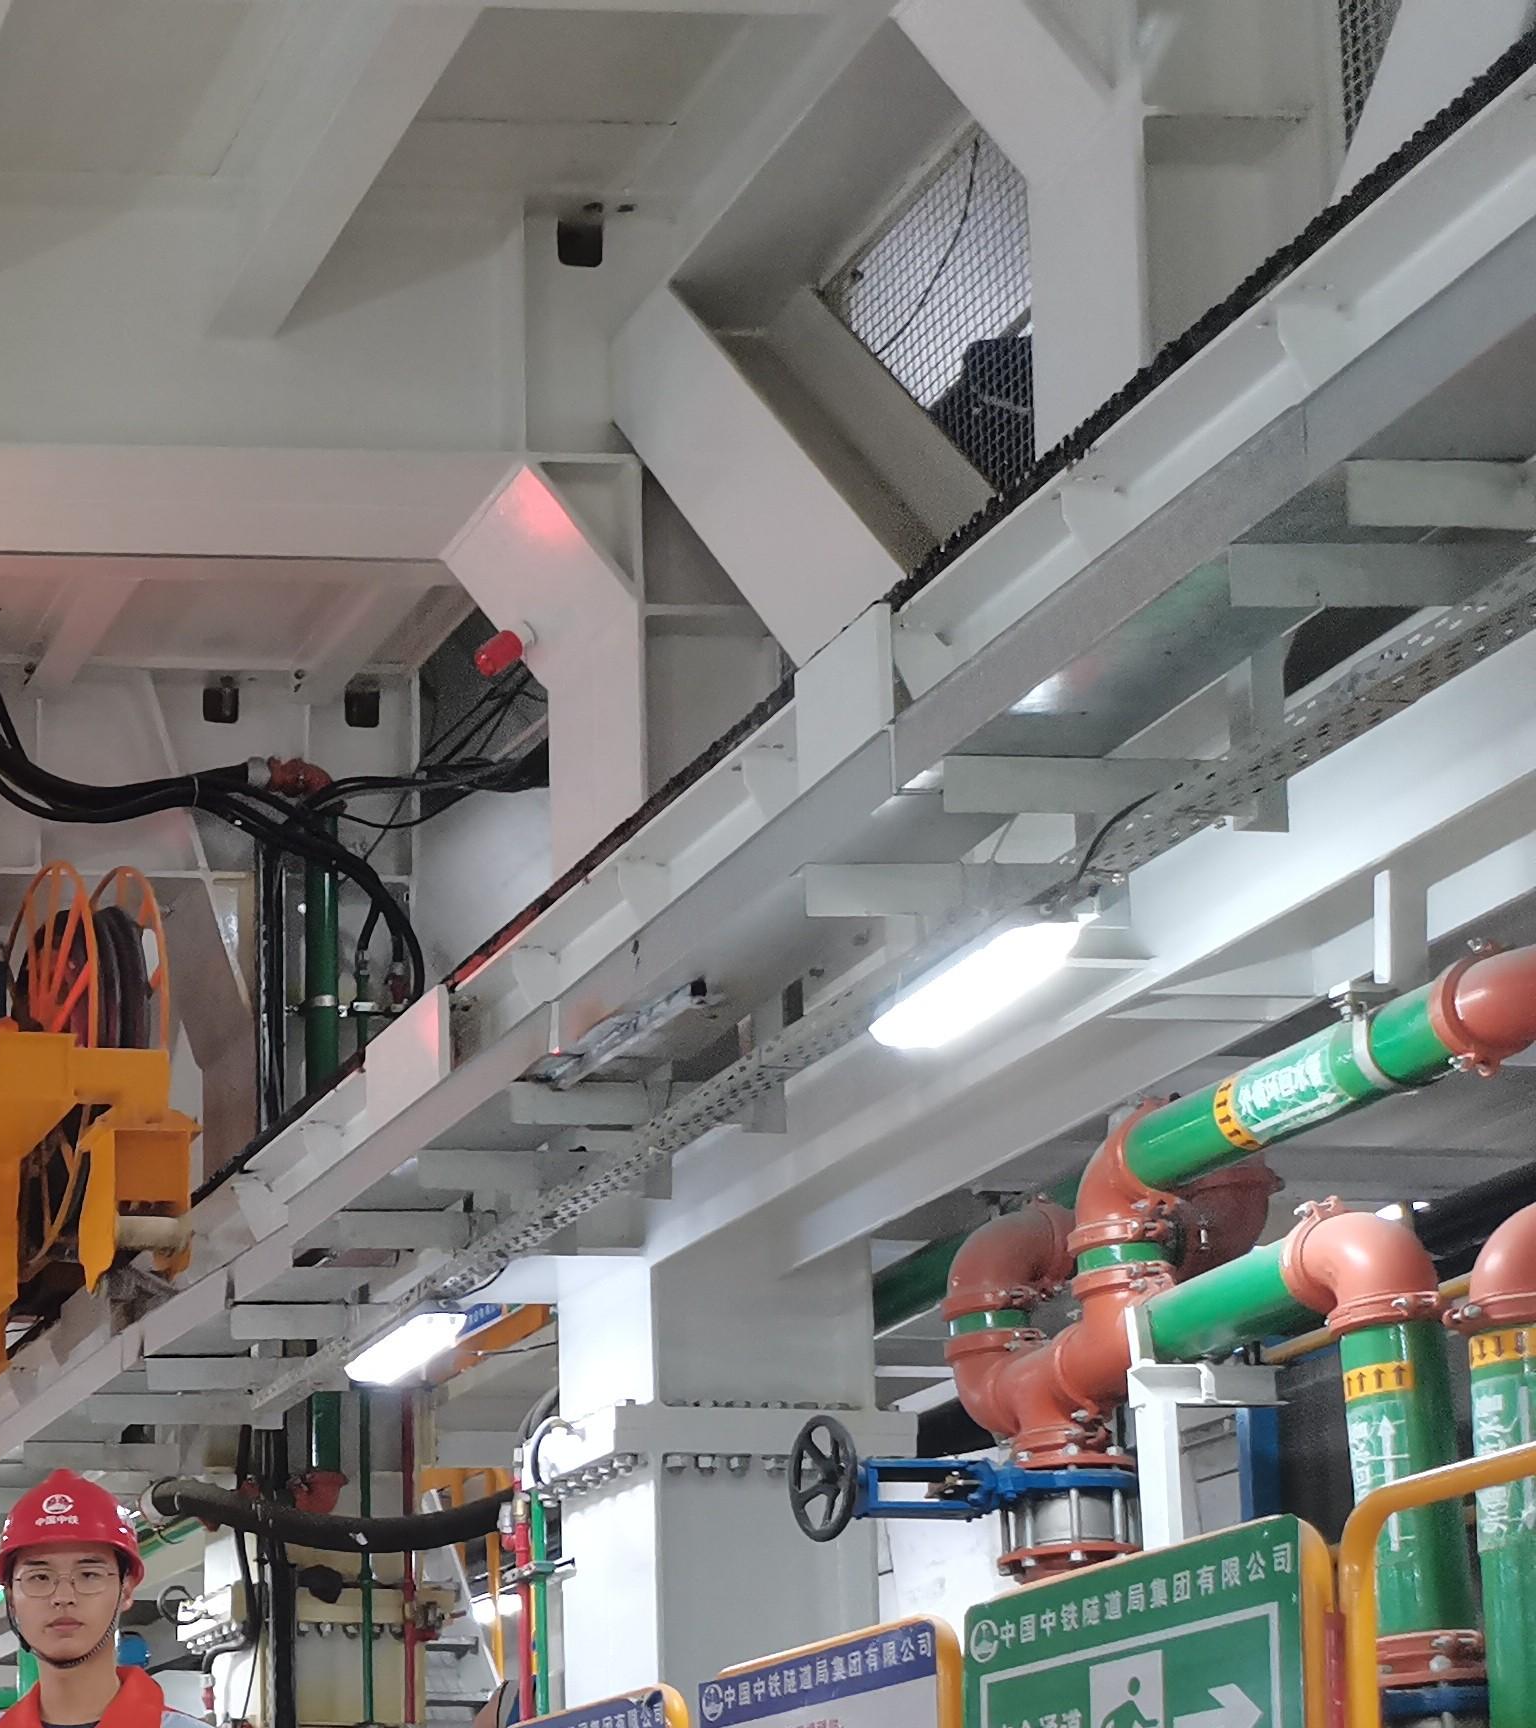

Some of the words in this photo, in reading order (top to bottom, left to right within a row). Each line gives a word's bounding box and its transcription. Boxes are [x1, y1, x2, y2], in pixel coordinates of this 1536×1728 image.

[998, 1541, 1293, 1649] 中国中铁隧道局集团有限公司
[723, 1631, 934, 1710] 中国中铁隧道局集团有限公司
